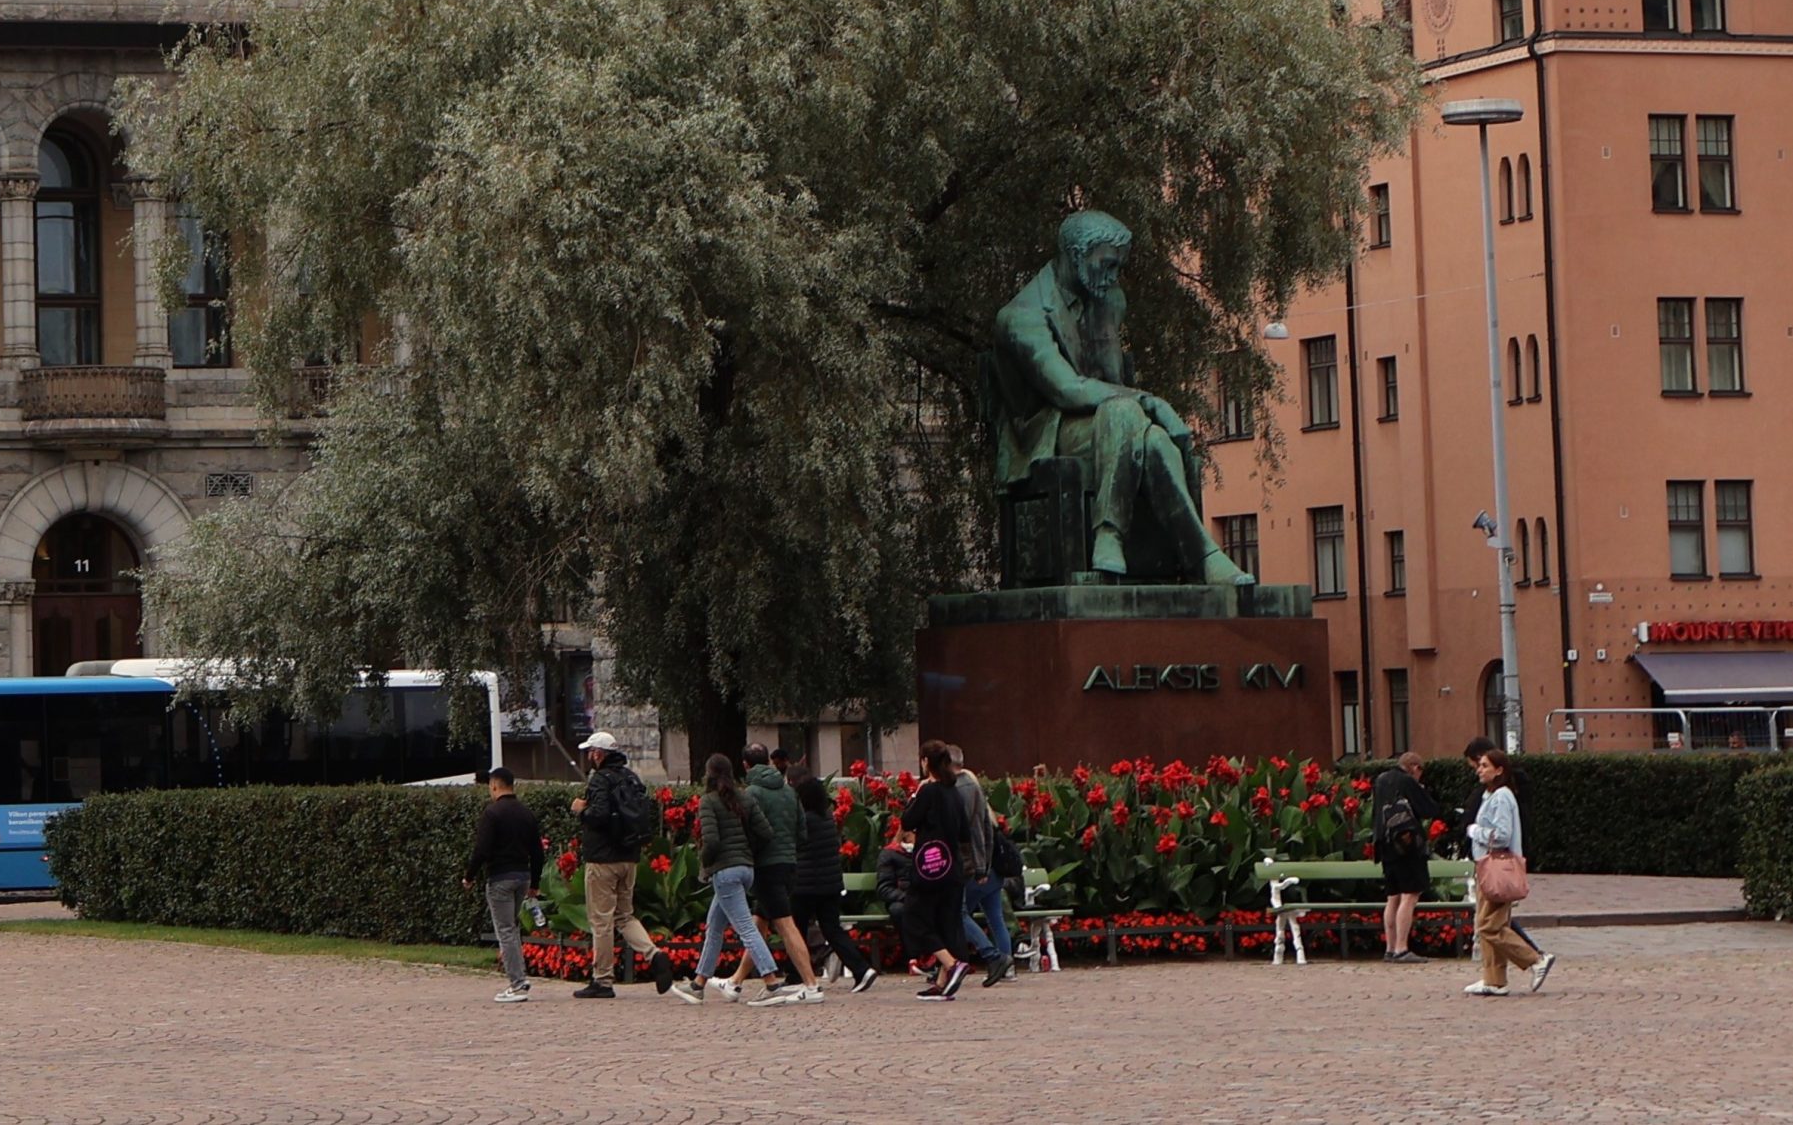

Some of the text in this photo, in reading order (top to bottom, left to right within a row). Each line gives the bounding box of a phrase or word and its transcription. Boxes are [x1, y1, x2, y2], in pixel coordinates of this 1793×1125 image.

[74, 559, 90, 573] 11
[1083, 664, 1307, 690] ALEKSIS KIVI
